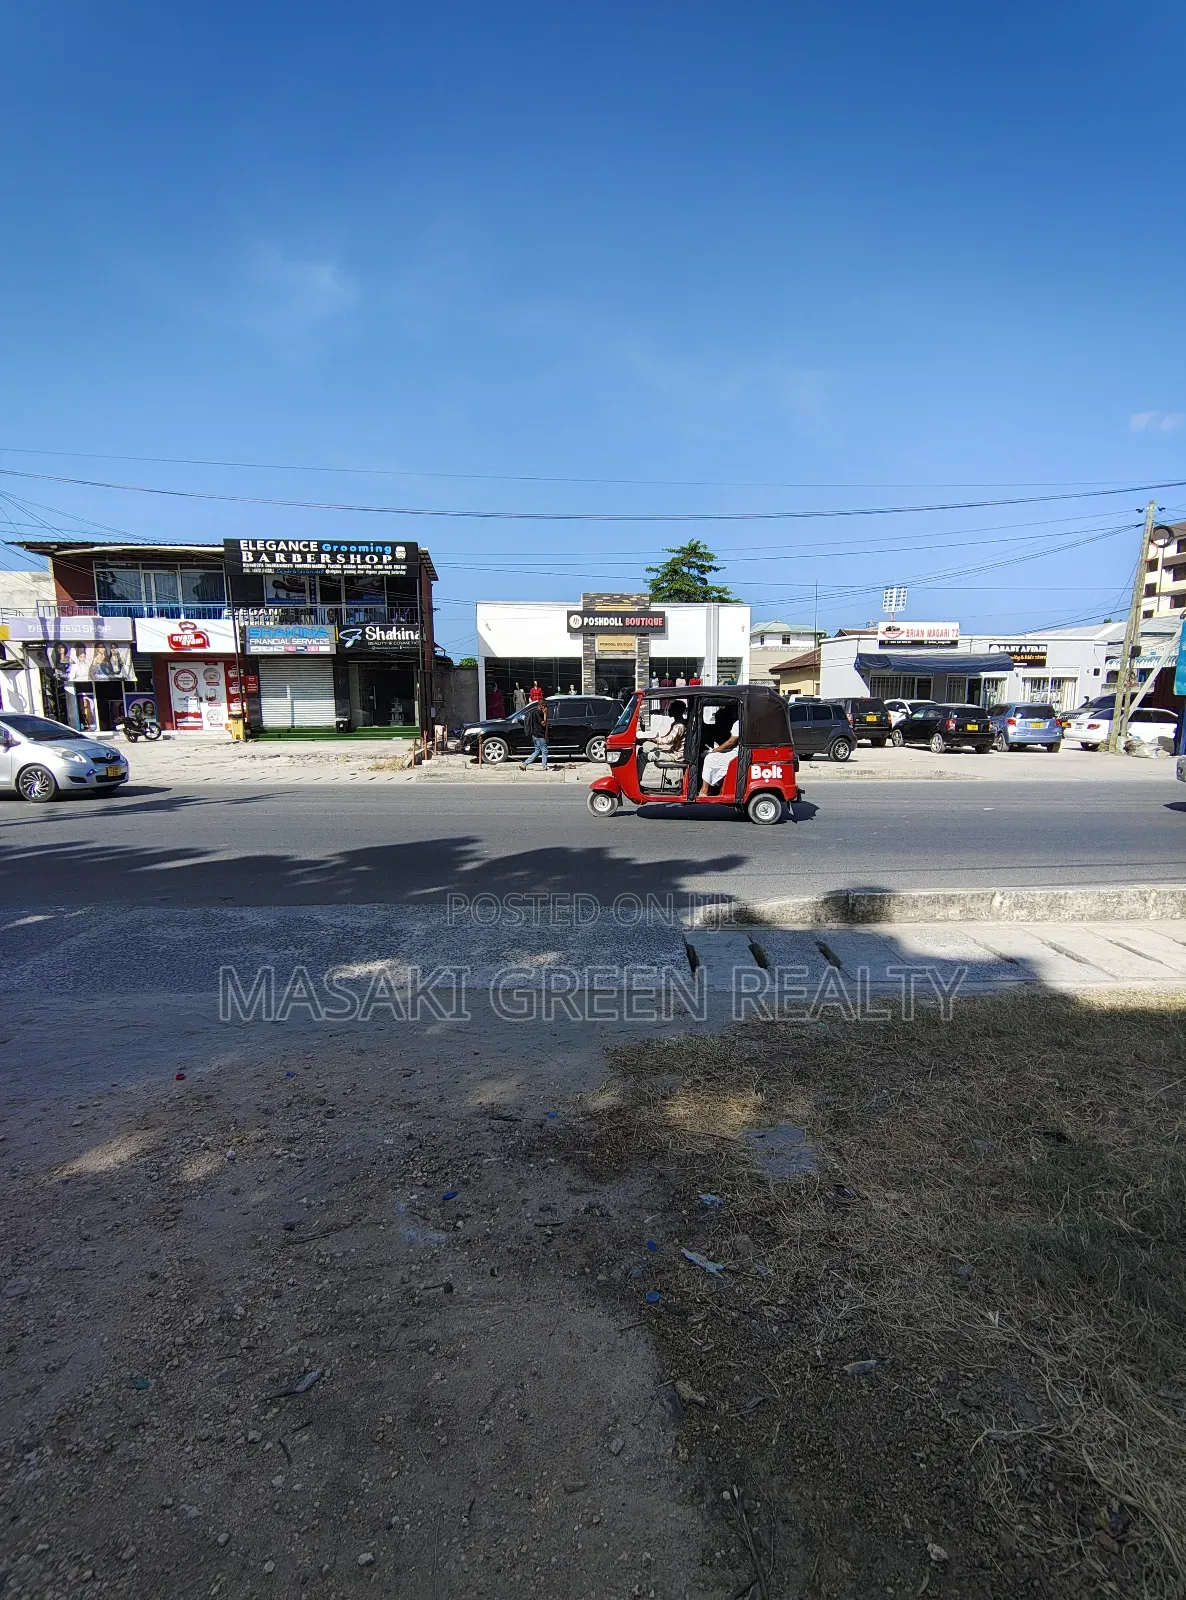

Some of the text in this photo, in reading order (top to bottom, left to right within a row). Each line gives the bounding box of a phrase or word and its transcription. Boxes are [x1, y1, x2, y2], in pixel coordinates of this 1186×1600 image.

[239, 540, 392, 554] ELEGANCE Grooming
[241, 551, 393, 564] BARBERSHOP
[583, 617, 663, 627] POSHDOLL BOUTIQUE
[82, 624, 112, 633] SHOP
[248, 626, 329, 638] SHAKINA
[365, 626, 420, 640] Shakina
[905, 628, 925, 638] BRIAN
[926, 628, 950, 638] MAGARI
[751, 765, 783, 780] Bolt
